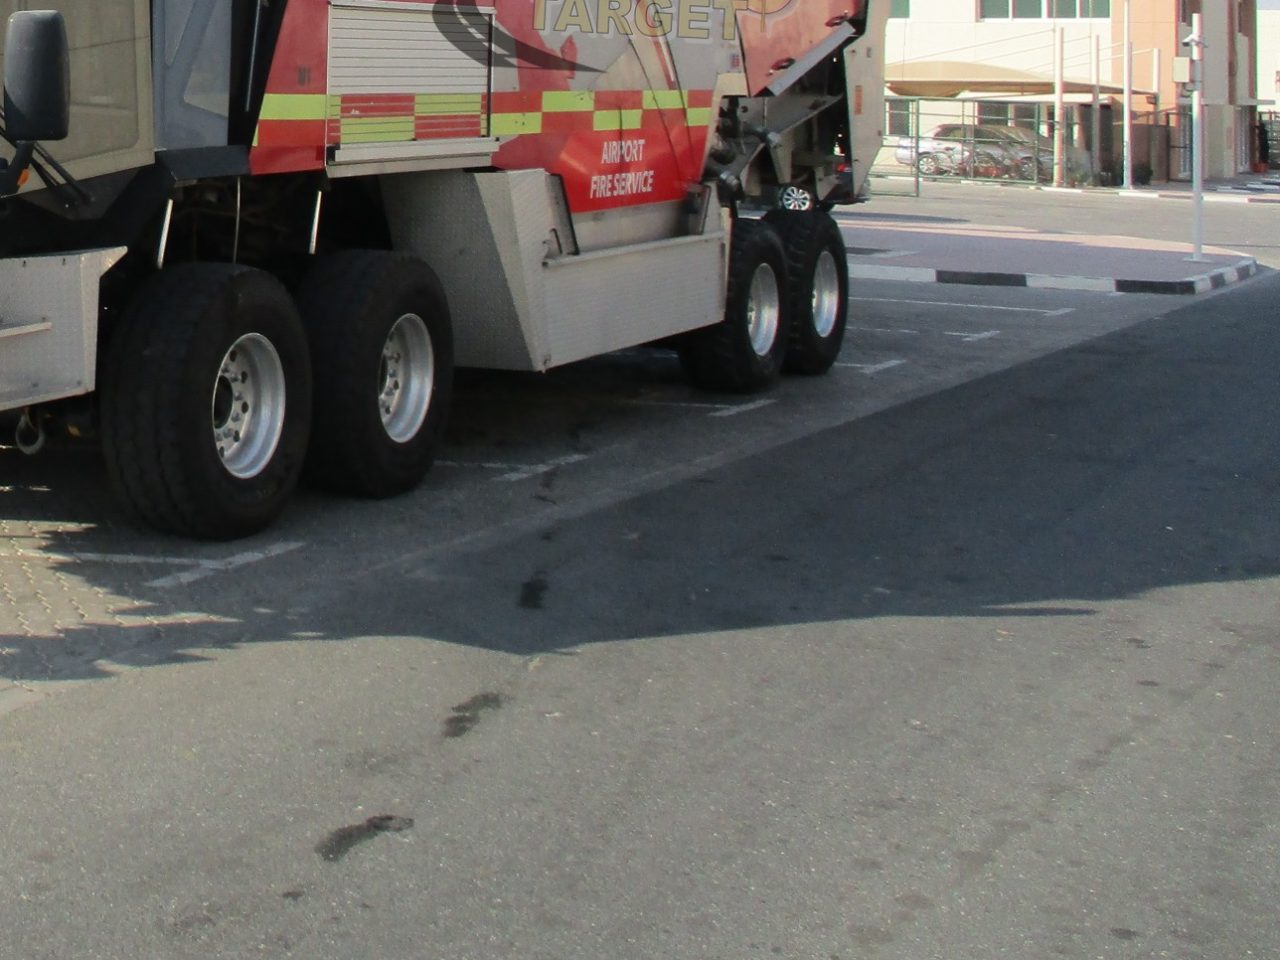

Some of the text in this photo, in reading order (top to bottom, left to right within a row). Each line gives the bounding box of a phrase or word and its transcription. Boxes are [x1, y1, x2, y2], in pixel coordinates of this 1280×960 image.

[601, 138, 646, 164] AIRPORT
[589, 169, 655, 199] FIRE SERVICE
